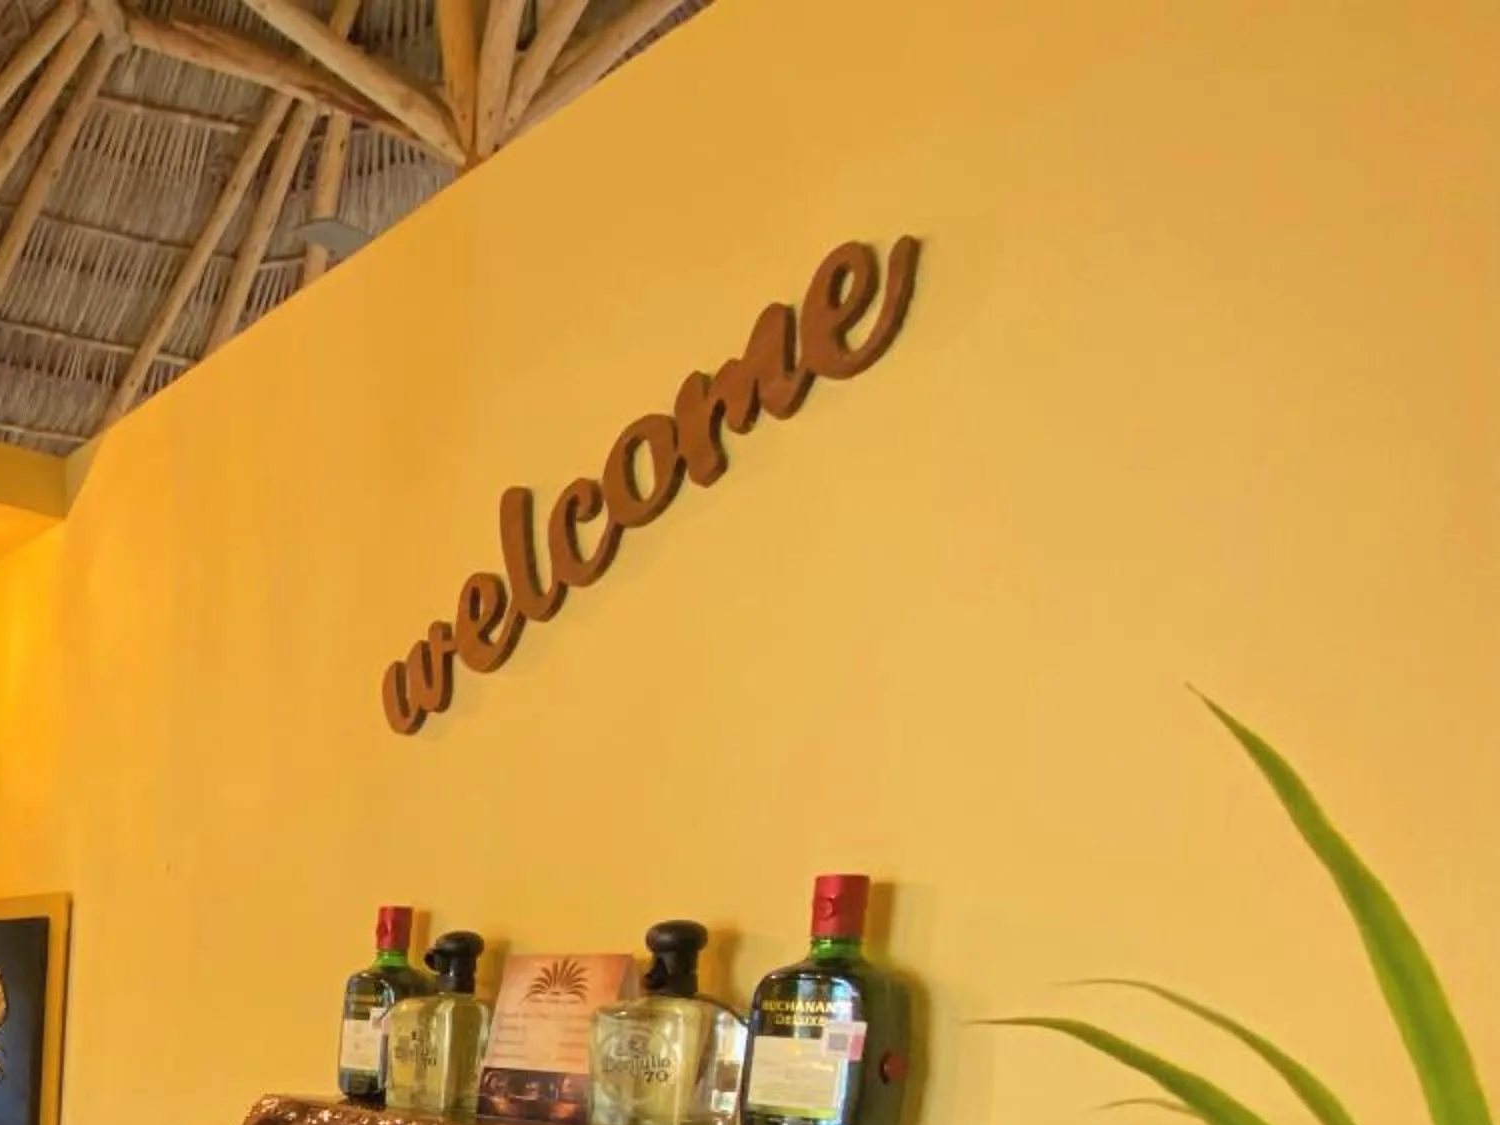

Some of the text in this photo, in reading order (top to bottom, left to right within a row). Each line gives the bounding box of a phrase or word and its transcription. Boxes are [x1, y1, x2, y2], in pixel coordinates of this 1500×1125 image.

[382, 235, 922, 735] welcome
[761, 1000, 849, 1014] BUCHANAN
[644, 1071, 669, 1084] 70
